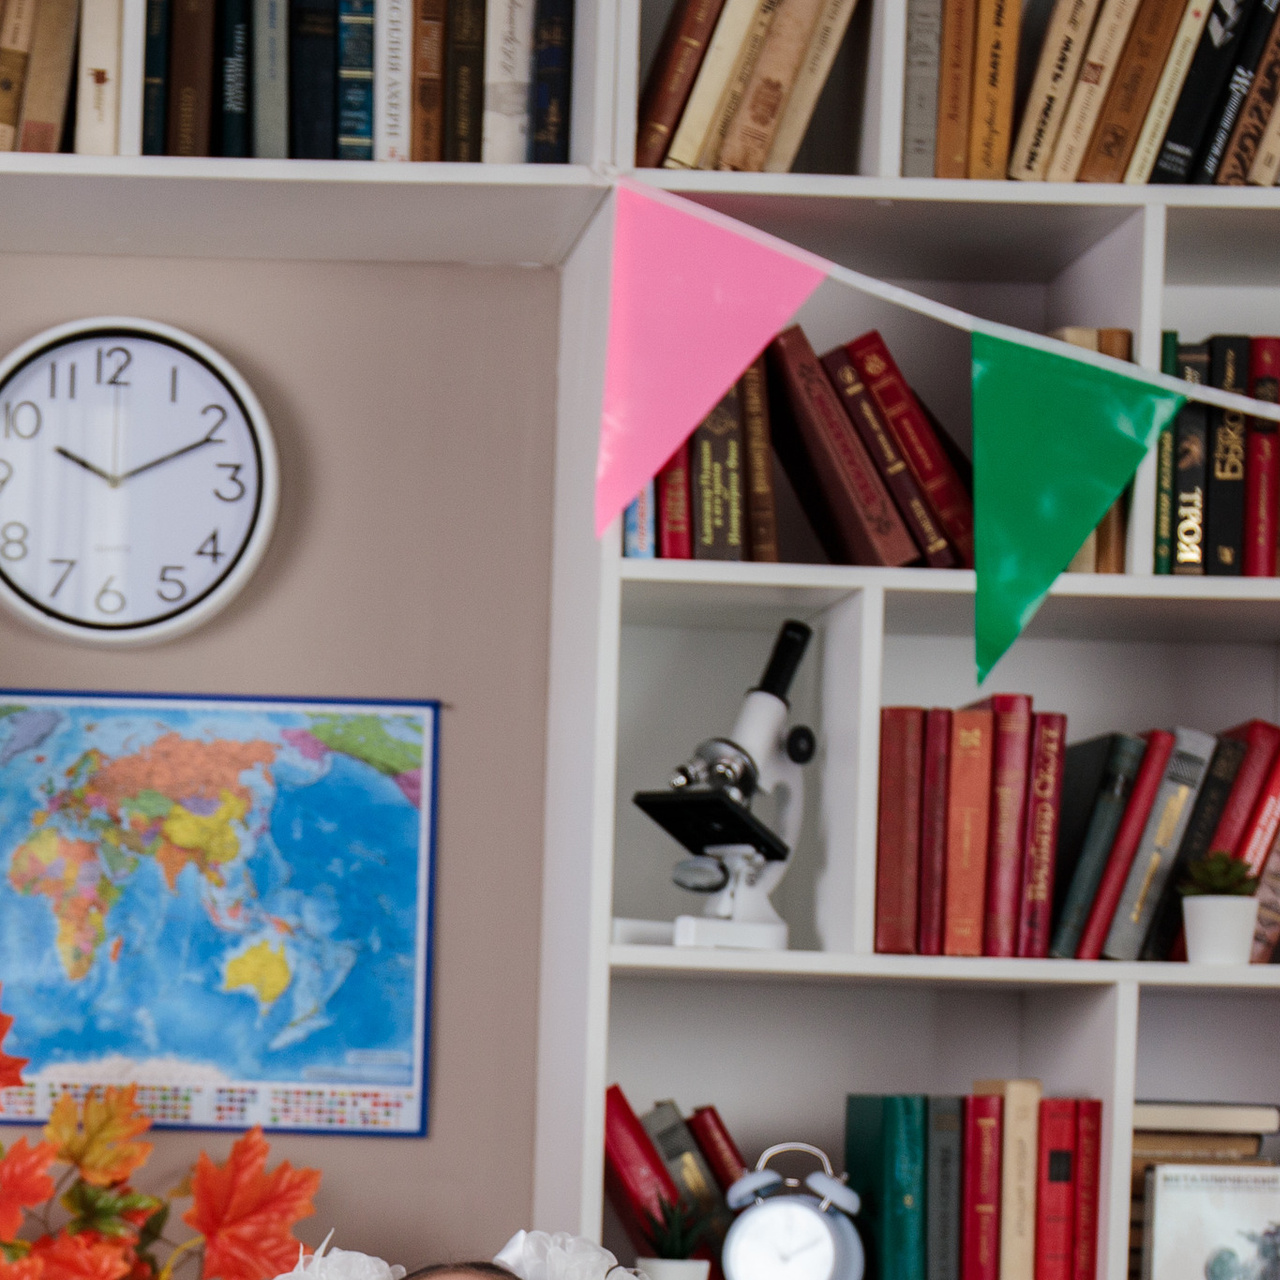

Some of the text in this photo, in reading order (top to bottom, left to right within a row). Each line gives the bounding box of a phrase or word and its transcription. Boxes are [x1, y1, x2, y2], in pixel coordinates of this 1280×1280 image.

[50, 362, 77, 399] 11
[96, 347, 132, 386] 12
[171, 366, 177, 402] 1
[5, 401, 42, 439] 10
[201, 404, 227, 443] 2
[214, 463, 246, 502] 3
[0, 522, 28, 562] 8
[196, 528, 224, 563] 4
[50, 559, 77, 597] 7
[95, 576, 126, 613] 6
[157, 566, 186, 603] 5
[1163, 1174, 1279, 1184] МЕТАЛЛИЧЕСКИЙ
